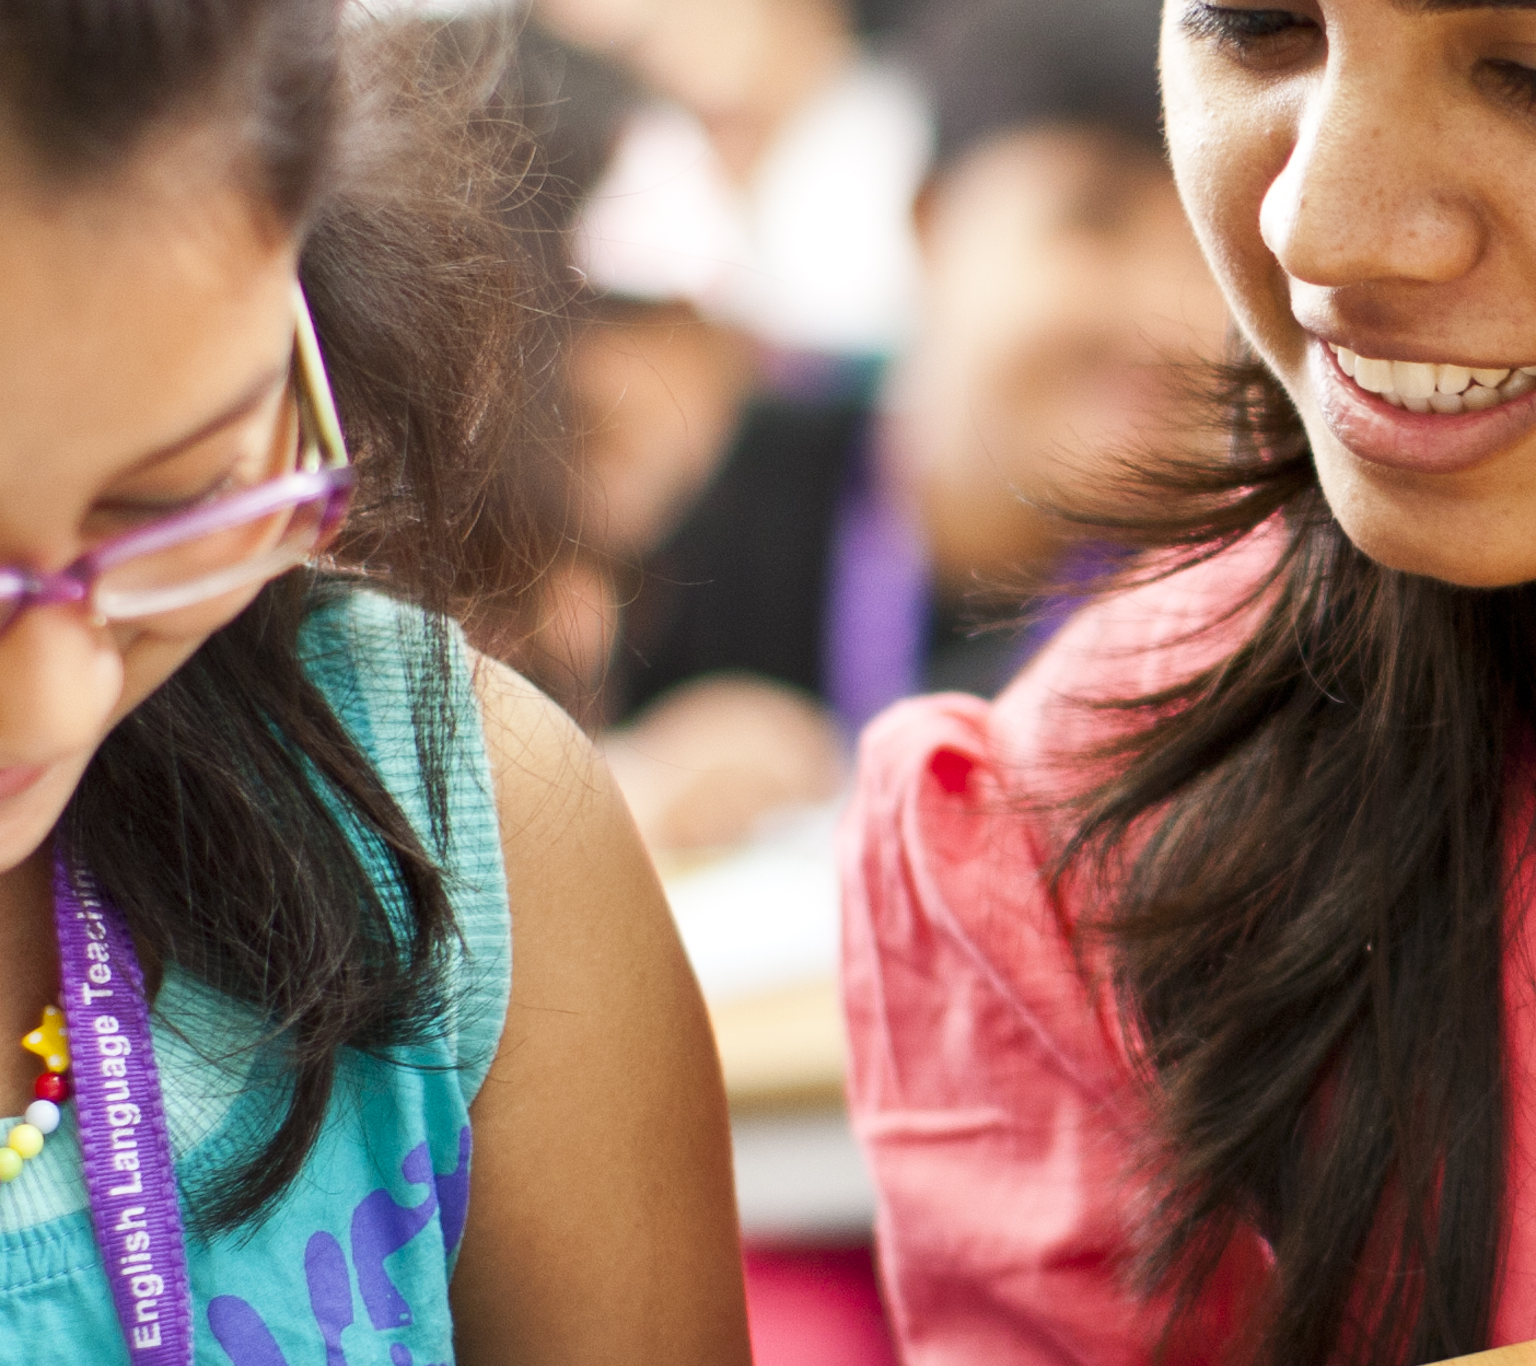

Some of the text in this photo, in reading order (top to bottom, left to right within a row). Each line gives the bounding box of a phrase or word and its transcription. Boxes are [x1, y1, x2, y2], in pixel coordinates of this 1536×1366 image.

[73, 851, 164, 1349] English Language Teachin
